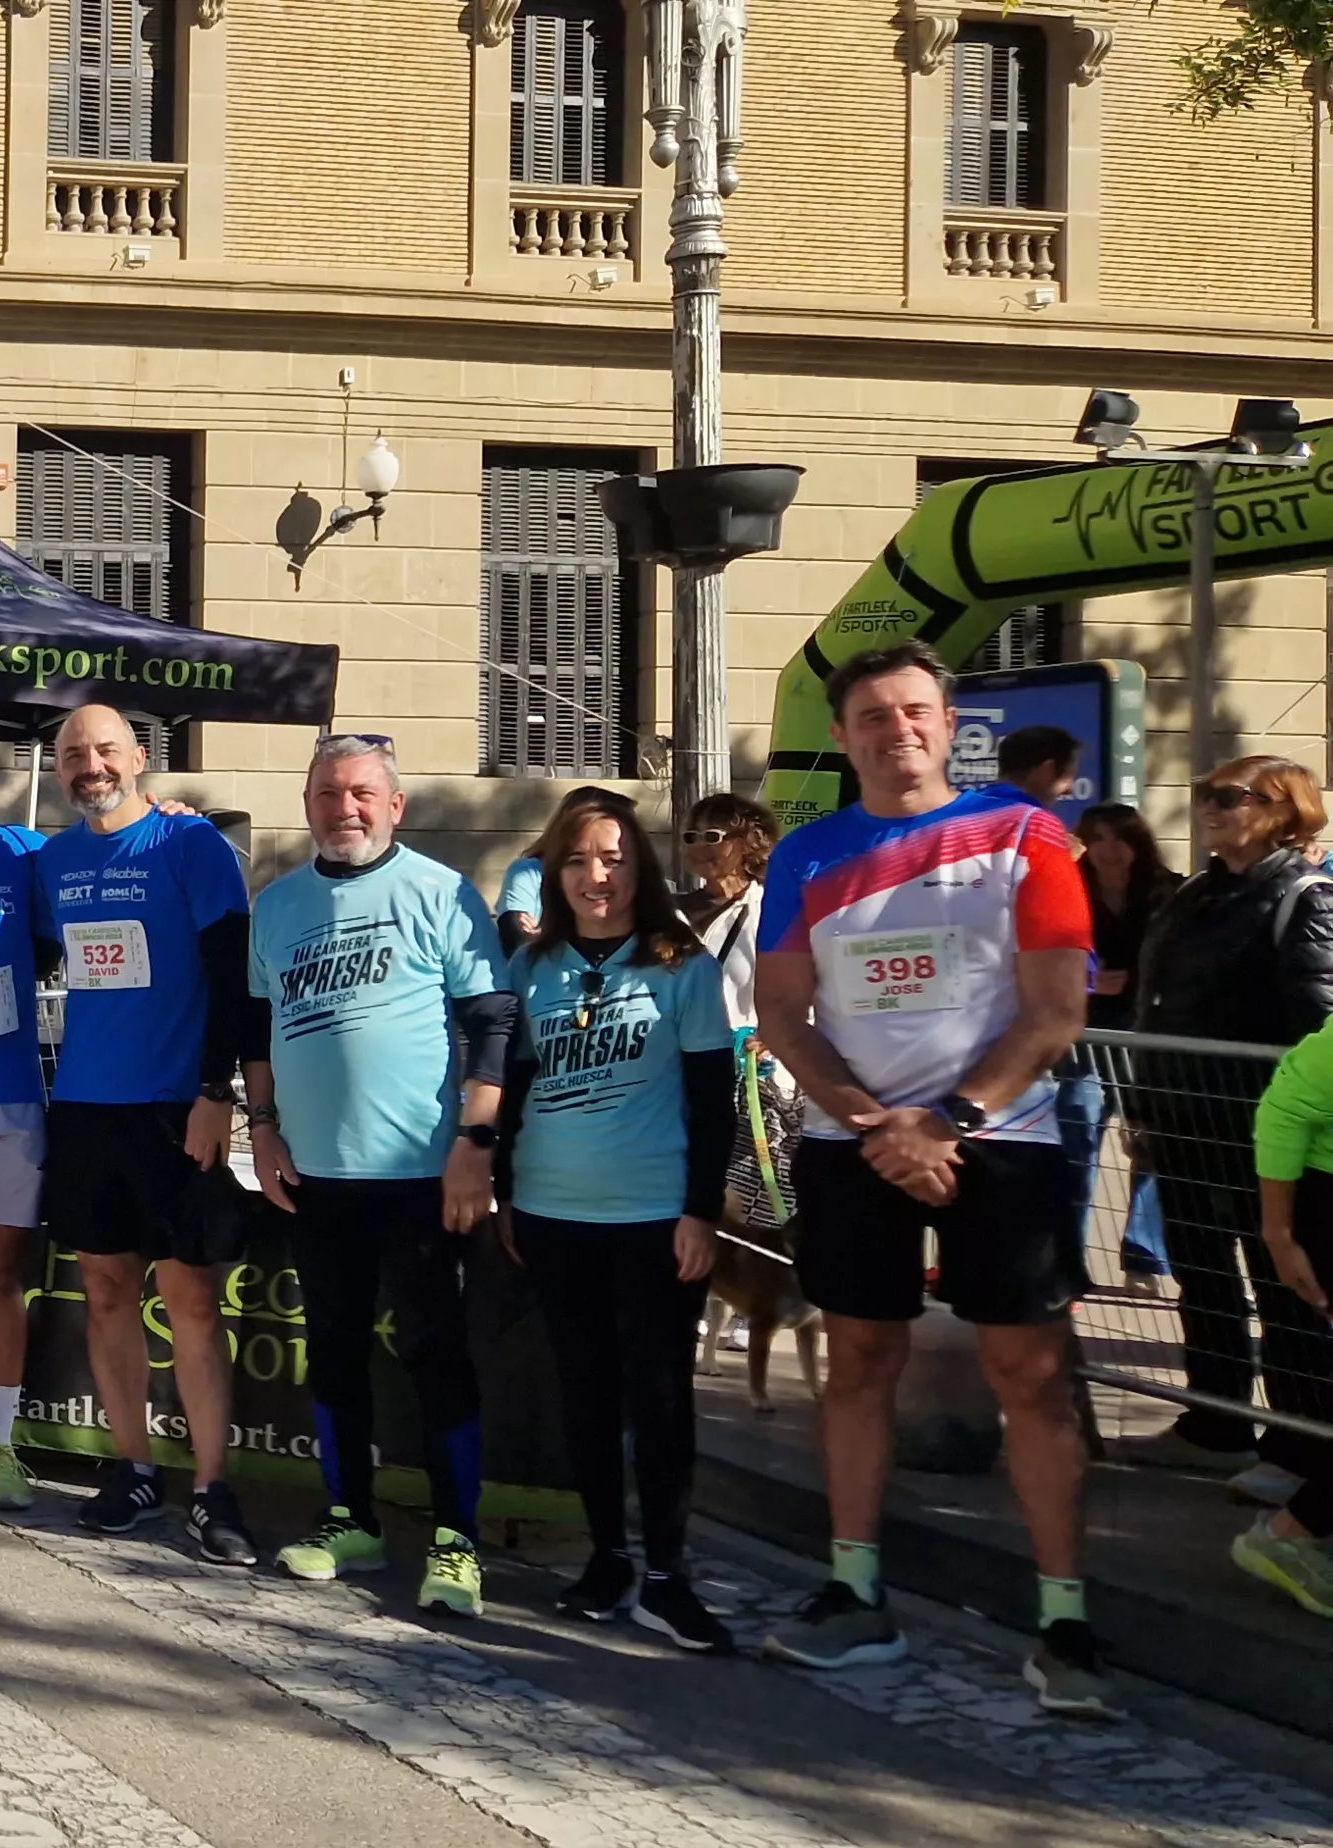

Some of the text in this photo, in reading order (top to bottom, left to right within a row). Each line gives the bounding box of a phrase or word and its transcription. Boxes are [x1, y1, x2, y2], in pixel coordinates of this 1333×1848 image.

[113, 867, 149, 879] kablex
[59, 885, 94, 902] NEXT
[83, 944, 126, 965] 532
[293, 934, 372, 965] III CARRERA
[89, 967, 119, 976] DAVID
[280, 946, 393, 1008] EMPRESAS
[865, 955, 936, 984] 398
[880, 984, 924, 996] JOSE
[291, 990, 357, 1017] ESIC HUESCA
[877, 997, 900, 1010] 8K
[541, 1017, 559, 1037] III
[536, 1019, 650, 1081] MPRESAS
[543, 1067, 613, 1092] ESIC HUESCA
